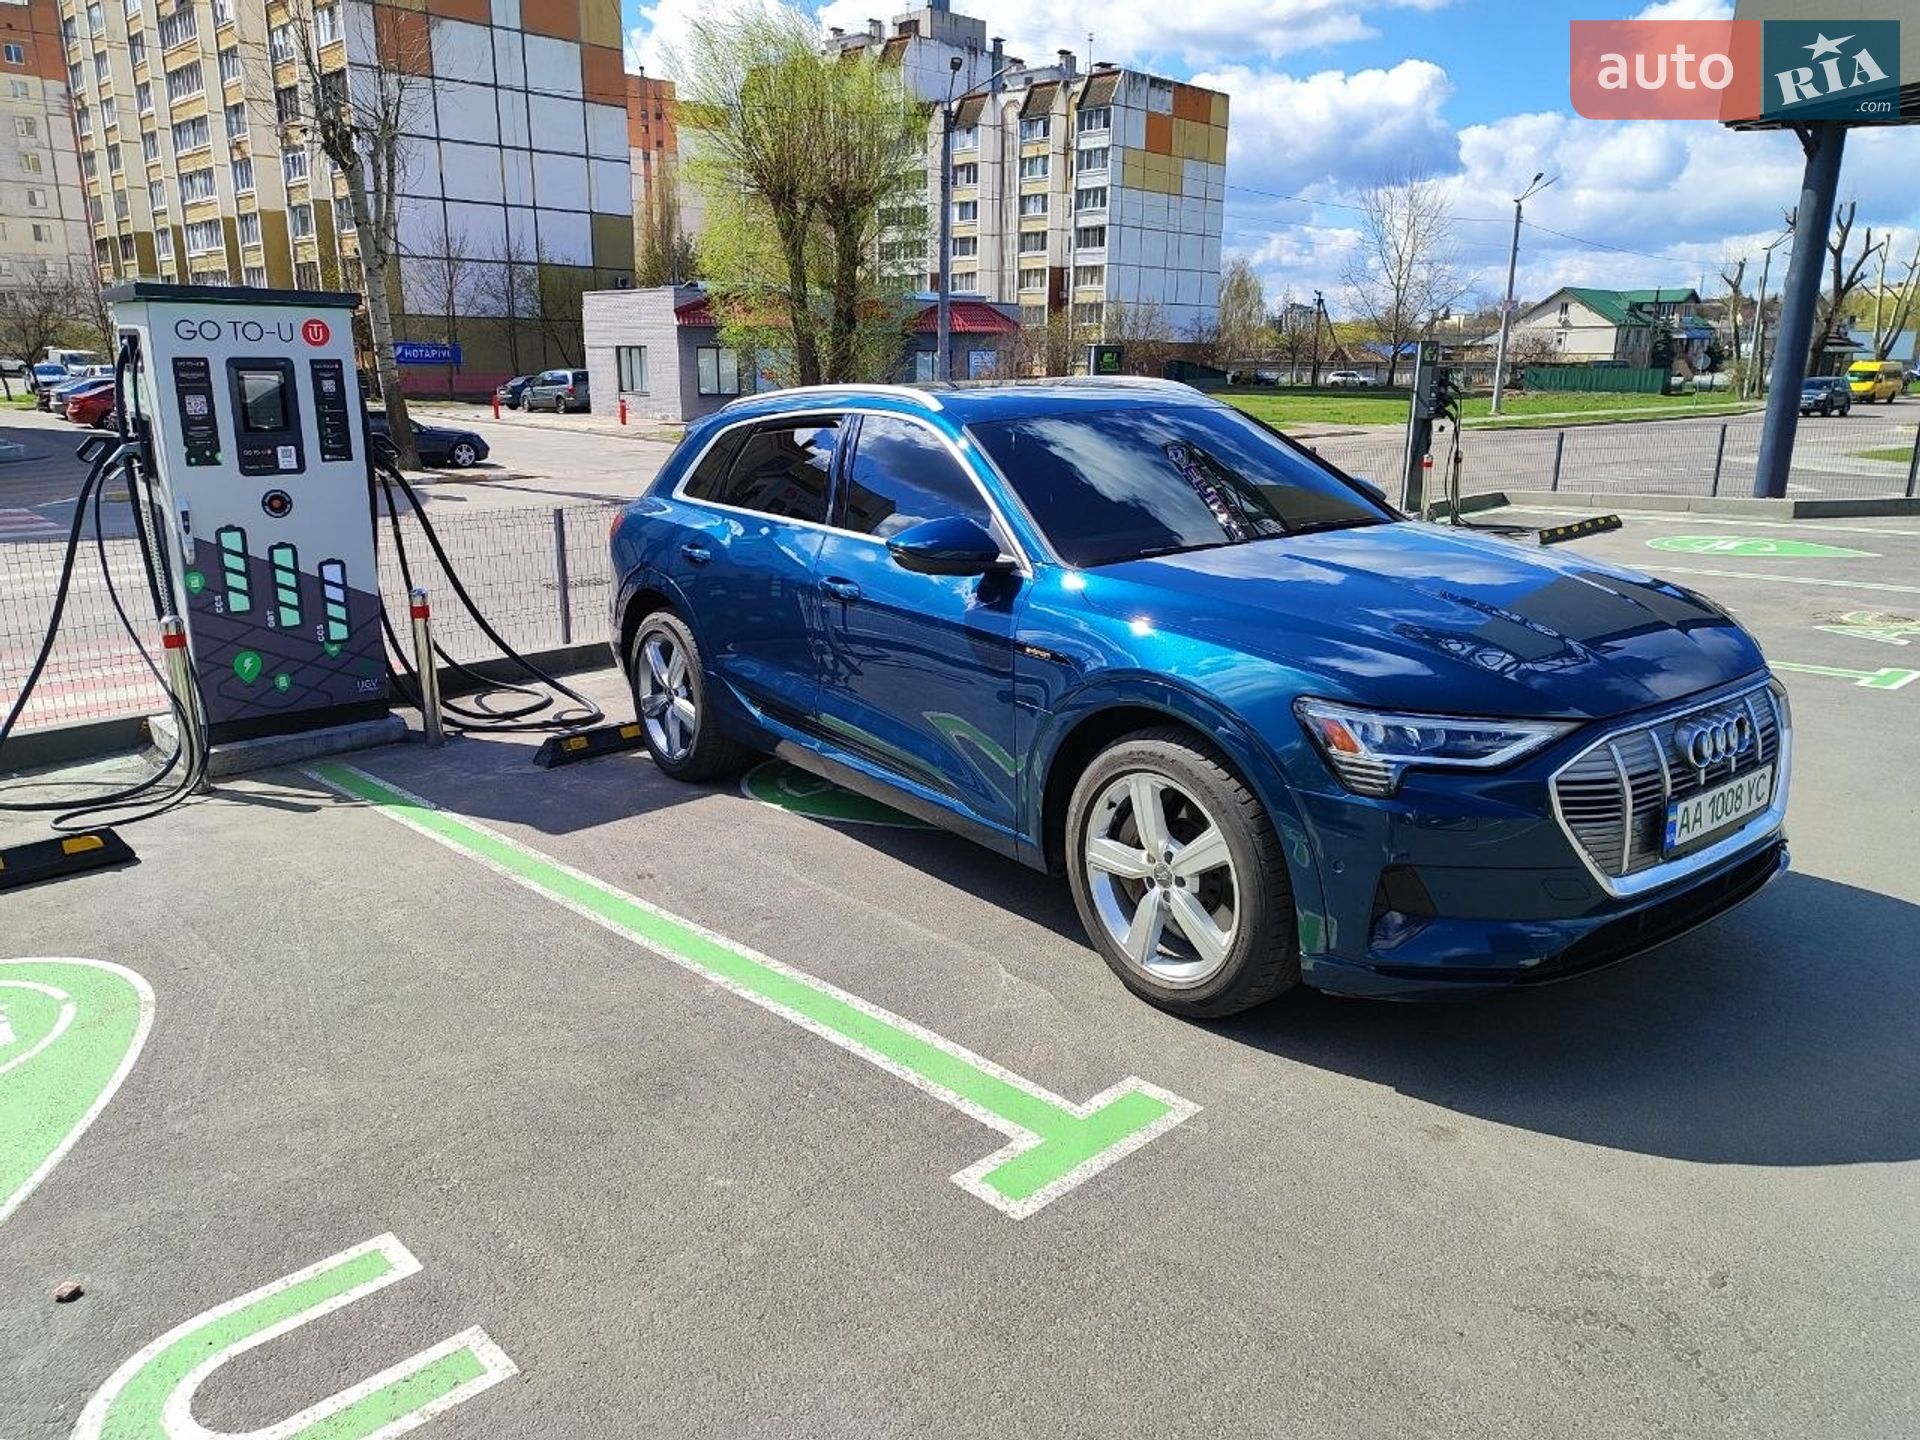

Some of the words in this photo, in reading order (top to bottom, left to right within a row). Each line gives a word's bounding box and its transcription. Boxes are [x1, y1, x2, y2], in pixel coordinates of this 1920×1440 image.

[174, 319, 221, 341] GO
[227, 321, 294, 342] TO-U
[215, 595, 223, 613] CCS
[316, 624, 325, 641] CCS
[1679, 801, 1703, 838] AA
[1709, 785, 1744, 824] 1008
[1748, 774, 1767, 806] YC
